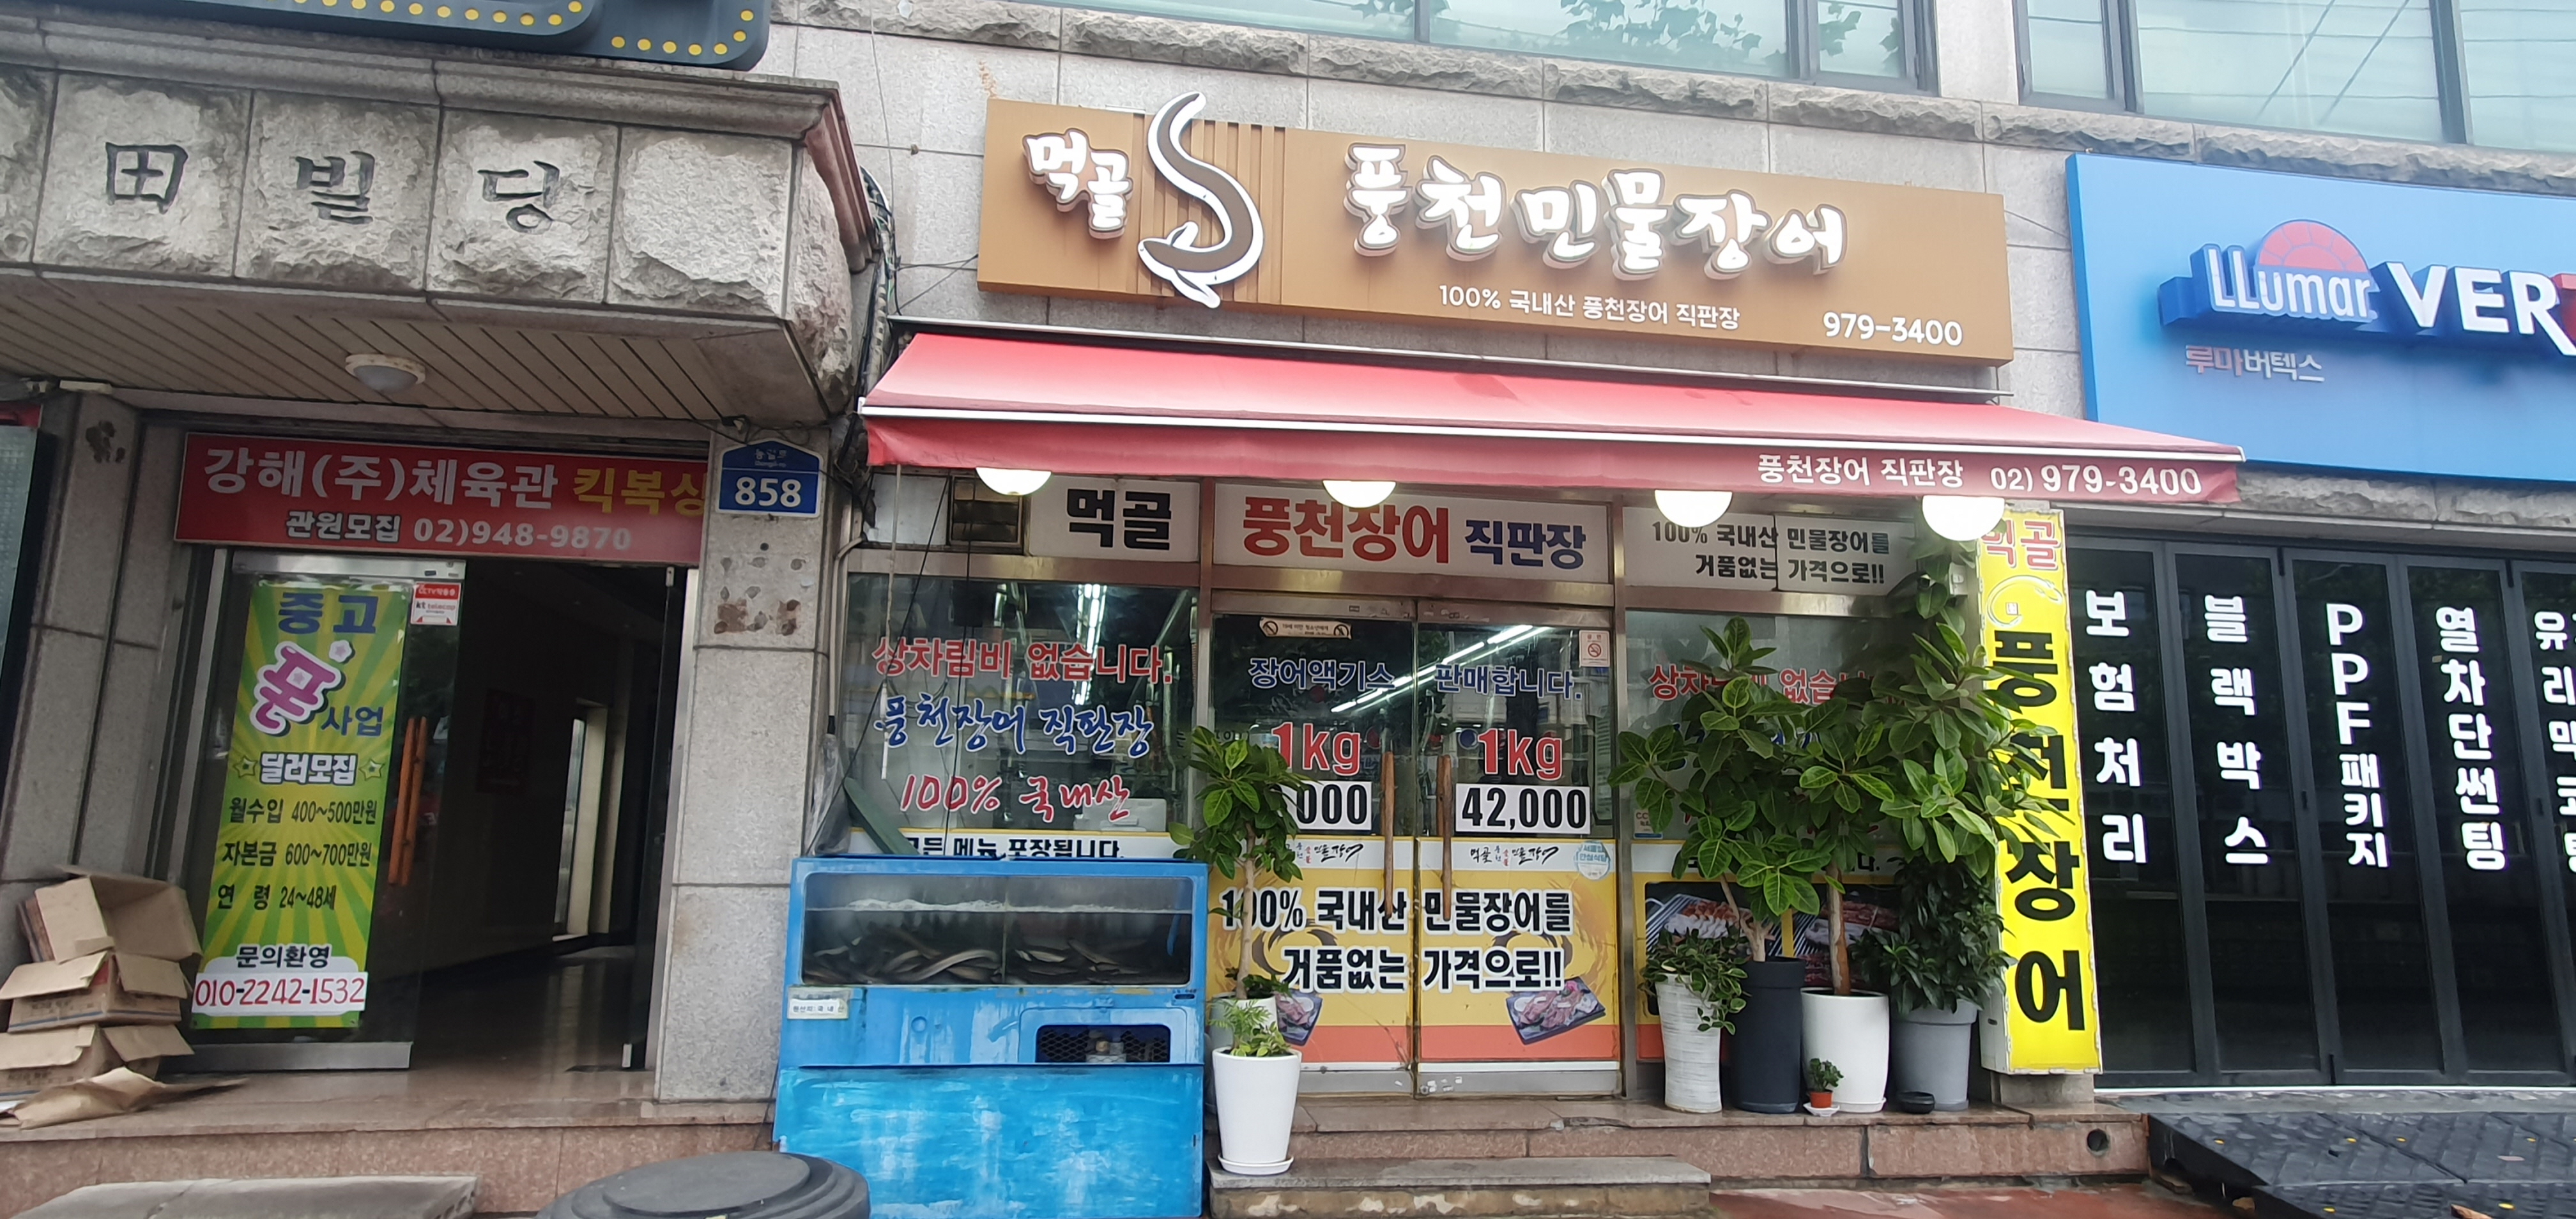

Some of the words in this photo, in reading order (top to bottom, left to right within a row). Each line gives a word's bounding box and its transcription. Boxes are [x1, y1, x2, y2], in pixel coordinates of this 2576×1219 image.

[1024, 129, 1131, 235] 먹골
[1346, 143, 1846, 279] 풍천민물장어
[2207, 248, 2371, 319] LLumar
[1439, 284, 1501, 311] 100%
[1509, 289, 1575, 318] 국내산
[1583, 295, 1669, 325] 풍천장어
[1676, 302, 1740, 330] 직판장
[2386, 261, 2576, 356] VER
[1823, 311, 1963, 347] 979-3400
[2185, 345, 2325, 383] 루마버텍스
[204, 447, 558, 509] 강해(주)체육관
[735, 477, 801, 507] 858
[1758, 454, 1871, 486] 풍천장어
[1881, 458, 1963, 487] 직판장
[1990, 466, 2033, 492] 02)
[2043, 464, 2202, 496] 979-3400
[286, 510, 402, 543] 관원모집
[413, 518, 631, 551] 02)948-9870
[1066, 488, 1172, 551] 먹골
[1243, 496, 1449, 564] 풍천장어
[1465, 519, 1586, 570] 직판장
[1652, 521, 1708, 544] 100%
[1717, 524, 1777, 548] 국내산
[1788, 528, 1890, 554] 민물장어를
[1696, 555, 1777, 580] 거품없는
[1788, 559, 1885, 584] 가격으로!!
[278, 592, 379, 634] 중고
[873, 636, 1011, 678] 상차림비
[1027, 641, 1173, 684] 없습니다.
[1248, 657, 1396, 693] 장어액기스
[1434, 664, 1583, 700] 판매합니다.
[321, 705, 384, 737] 사업
[875, 692, 1026, 755] 풍천장어
[1039, 704, 1154, 758] 직판장
[2084, 589, 2148, 864] 보험처리
[2204, 594, 2271, 866] 블랙박스
[260, 753, 358, 785] 딜러모집
[1271, 722, 1361, 776] 1kg
[1478, 728, 1563, 781] 1kg
[229, 797, 284, 824] 월수입
[291, 800, 378, 825] 400~500만원
[900, 774, 1002, 814] 100%
[1020, 774, 1131, 823] 국내산
[1462, 787, 1586, 831] 42,000
[222, 841, 277, 867] 자본금
[285, 842, 372, 867] 600~700만원
[953, 838, 997, 857] 메뉴
[1470, 846, 1493, 864] 먹골
[279, 885, 337, 910] 24~48세
[1317, 890, 1407, 931] 국내산
[1424, 891, 1571, 932] 민물장어를
[236, 945, 330, 969] 문의환영
[1282, 948, 1406, 990] 거품없는
[1423, 949, 1561, 990] 가격으로!!
[195, 977, 365, 1007] 010-2242-1532
